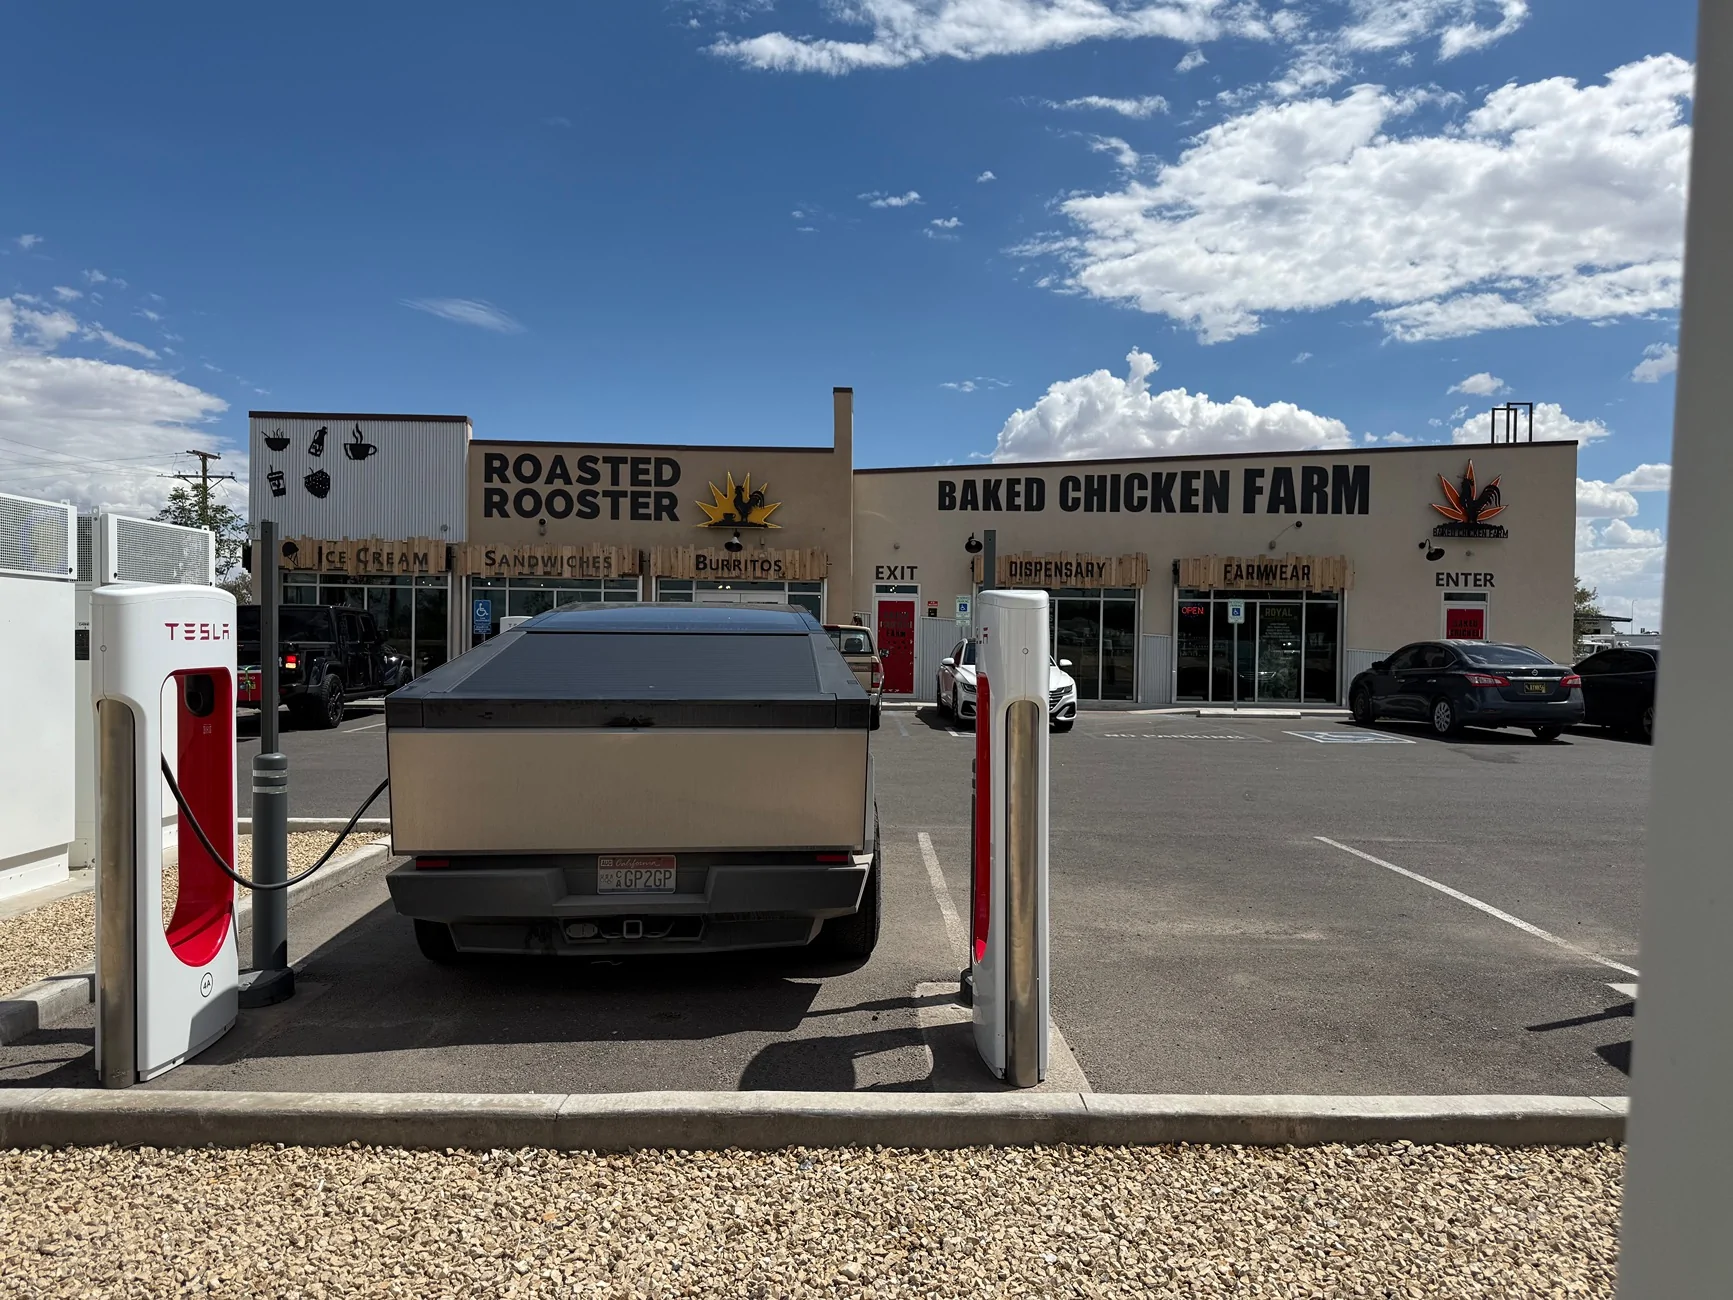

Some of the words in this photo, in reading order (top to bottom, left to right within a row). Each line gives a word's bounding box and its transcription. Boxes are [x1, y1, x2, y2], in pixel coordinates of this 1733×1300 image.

[484, 453, 681, 488] ROASTED
[937, 479, 1046, 512] BAKED
[1059, 470, 1230, 514] CHICKEN
[1242, 464, 1370, 515] FARM
[484, 488, 680, 521] ROOSTER
[1488, 528, 1509, 539] FARM
[356, 548, 428, 566] CREAM
[484, 550, 612, 569] SANDWICHES
[695, 554, 782, 572] BURRITOS
[875, 565, 918, 580] EXIT
[1009, 560, 1106, 578] DISPENSARY
[1223, 563, 1311, 581] FARMWEAR
[1435, 572, 1495, 587] ENTER
[1181, 606, 1204, 615] OPEN
[1265, 607, 1292, 617] ROYAL
[164, 623, 230, 640] TESLA
[615, 858, 660, 869] California
[624, 869, 673, 888] GP2GP
